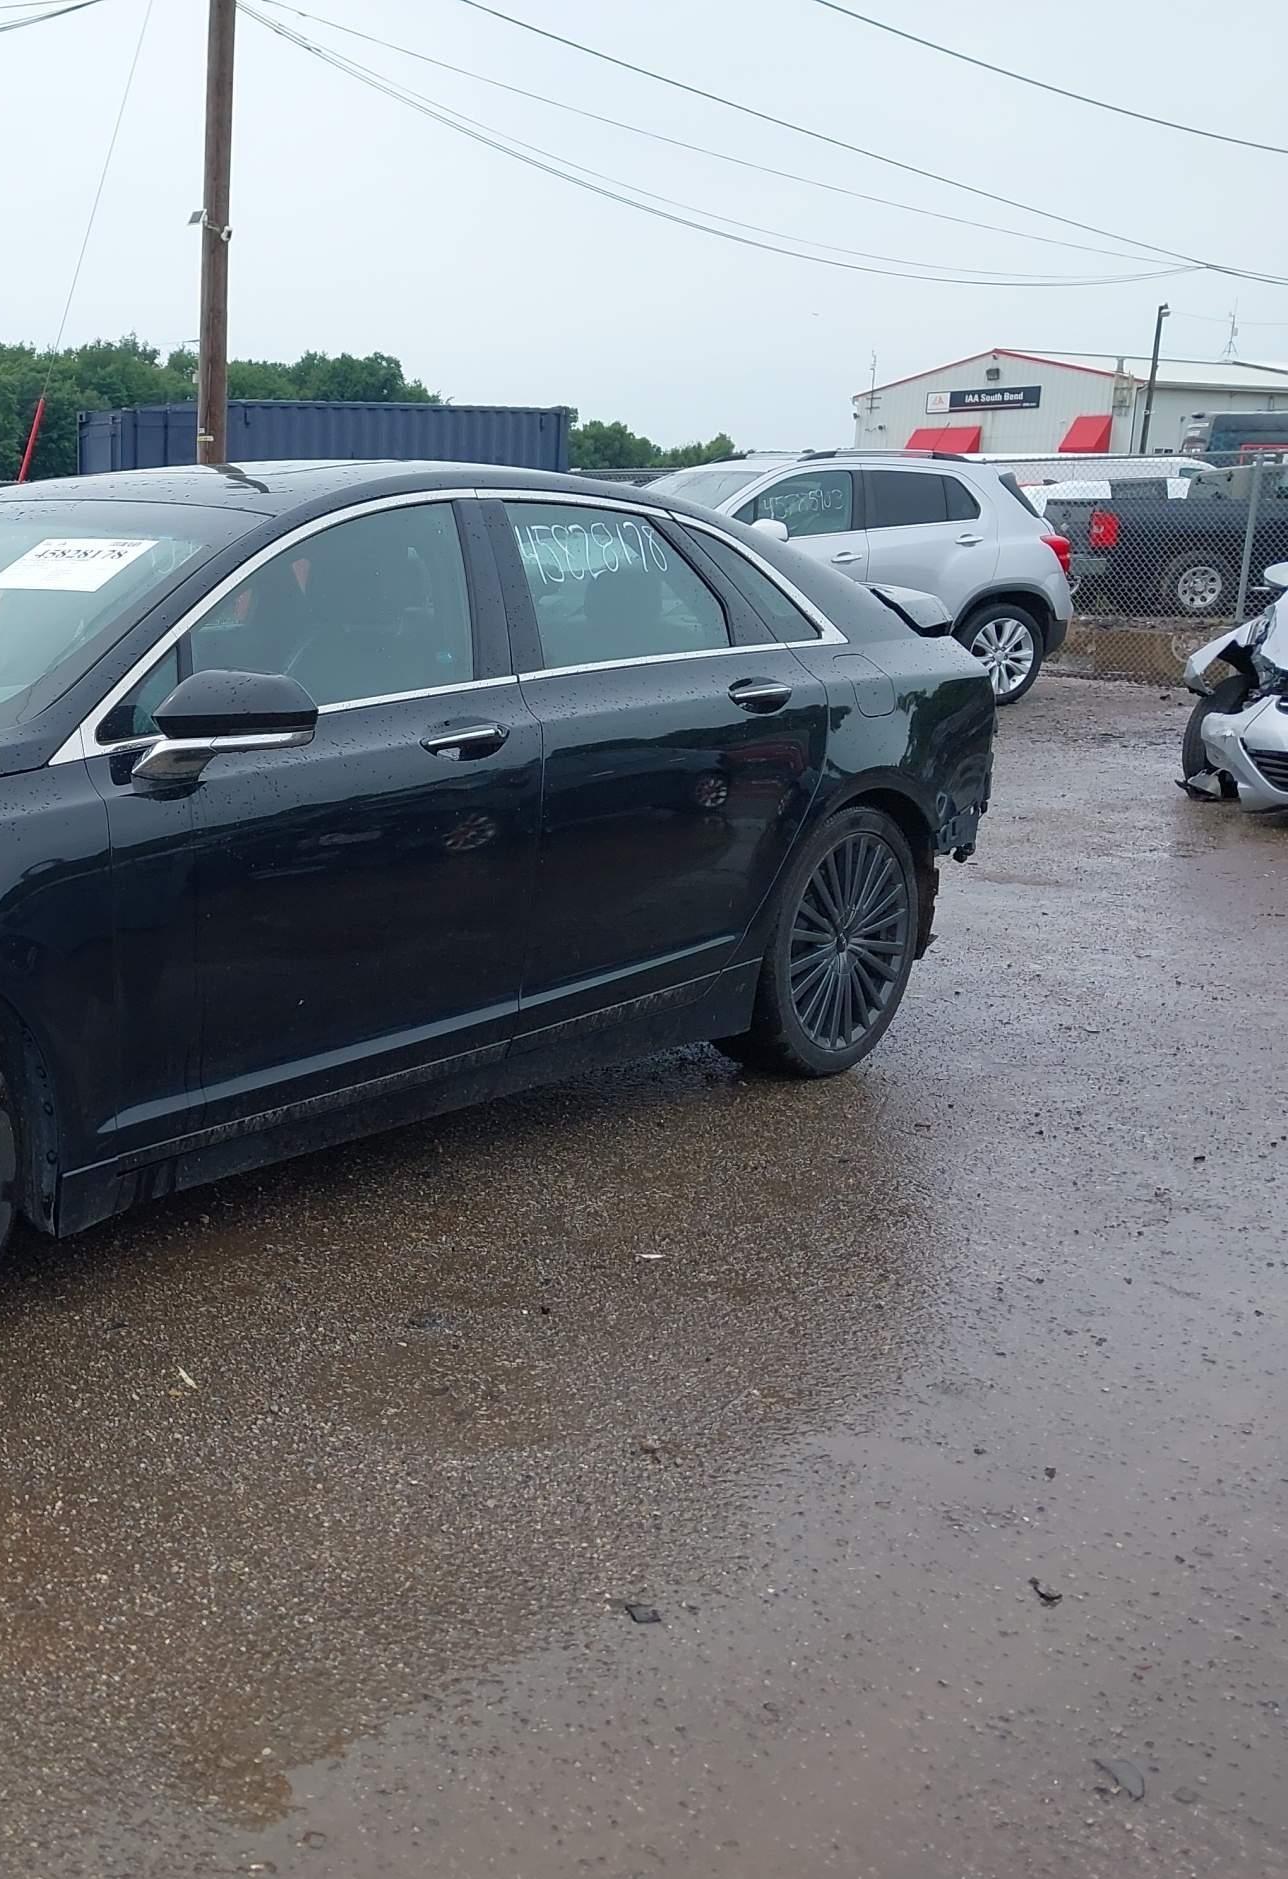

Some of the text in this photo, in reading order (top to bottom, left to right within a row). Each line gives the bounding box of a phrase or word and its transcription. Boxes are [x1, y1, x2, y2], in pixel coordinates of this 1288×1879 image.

[965, 391, 1024, 403] IAA South Bend
[514, 521, 668, 584] 45828178
